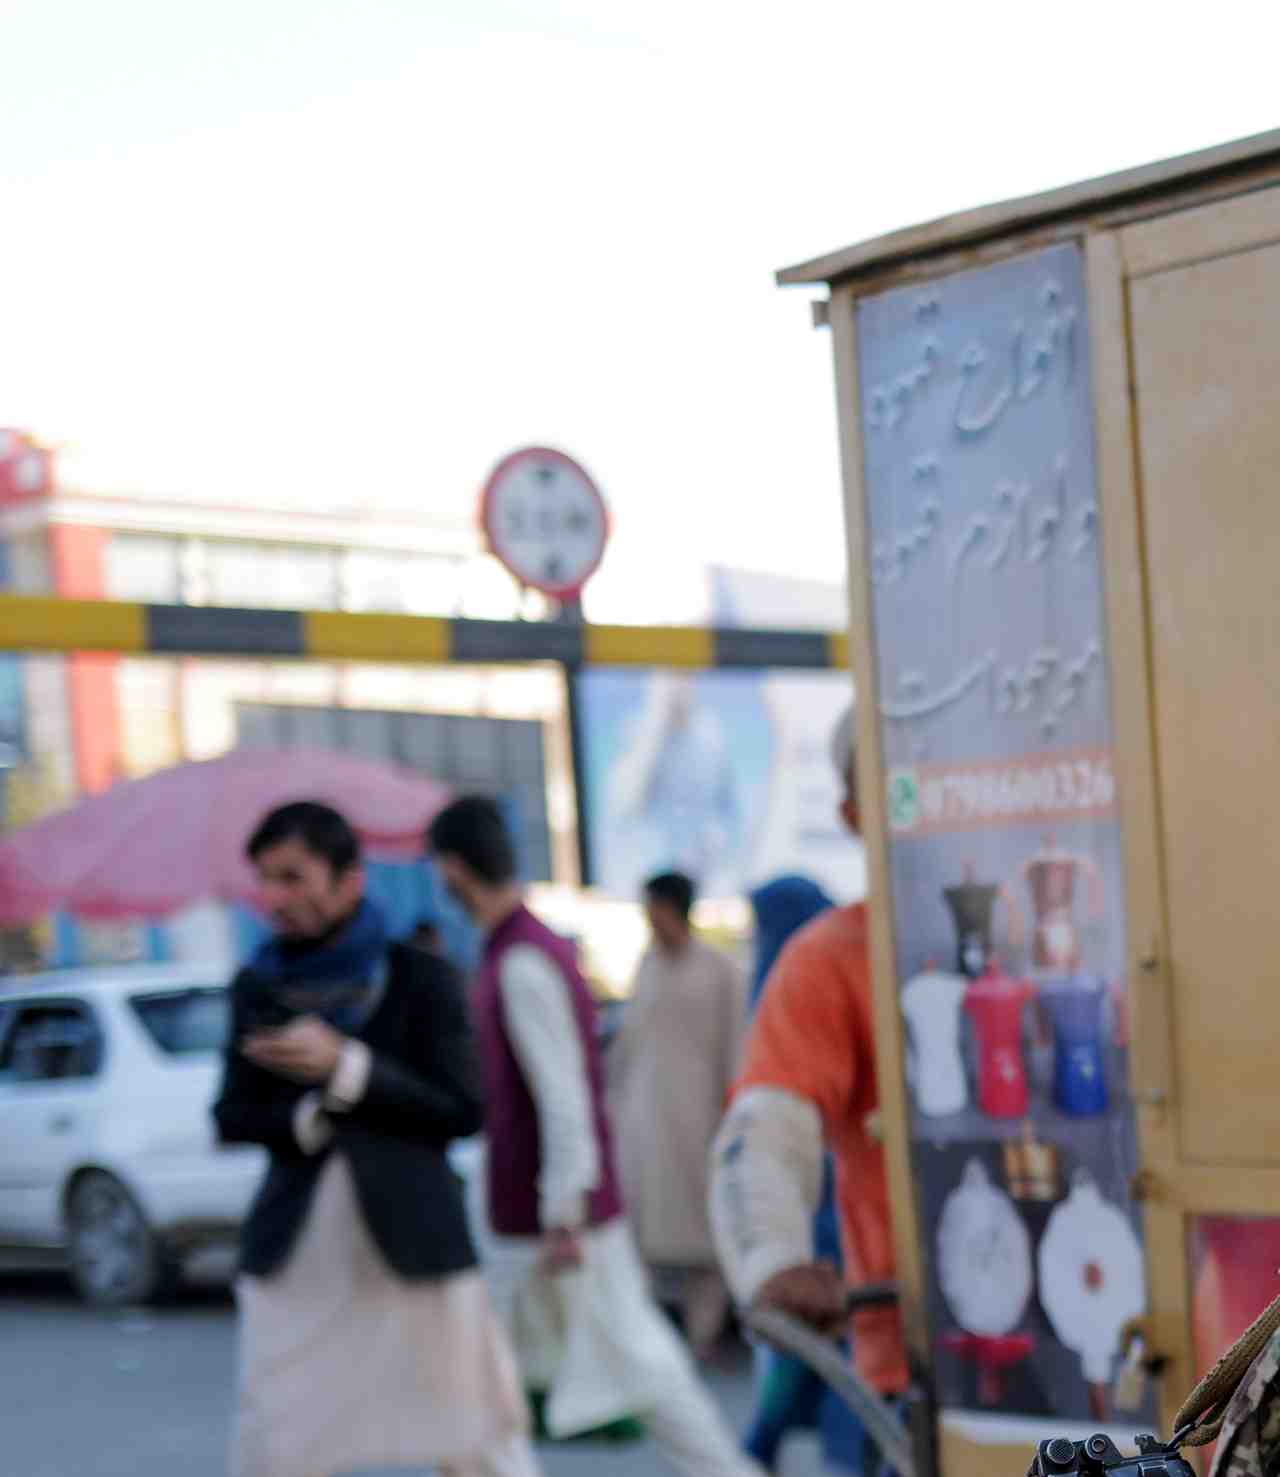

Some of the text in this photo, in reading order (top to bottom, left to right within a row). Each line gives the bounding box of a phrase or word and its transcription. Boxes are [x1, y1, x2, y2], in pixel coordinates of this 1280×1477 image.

[867, 278, 1079, 440] انواع قهوه
[871, 449, 943, 584] قهوه
[947, 451, 1068, 582] لوازم
